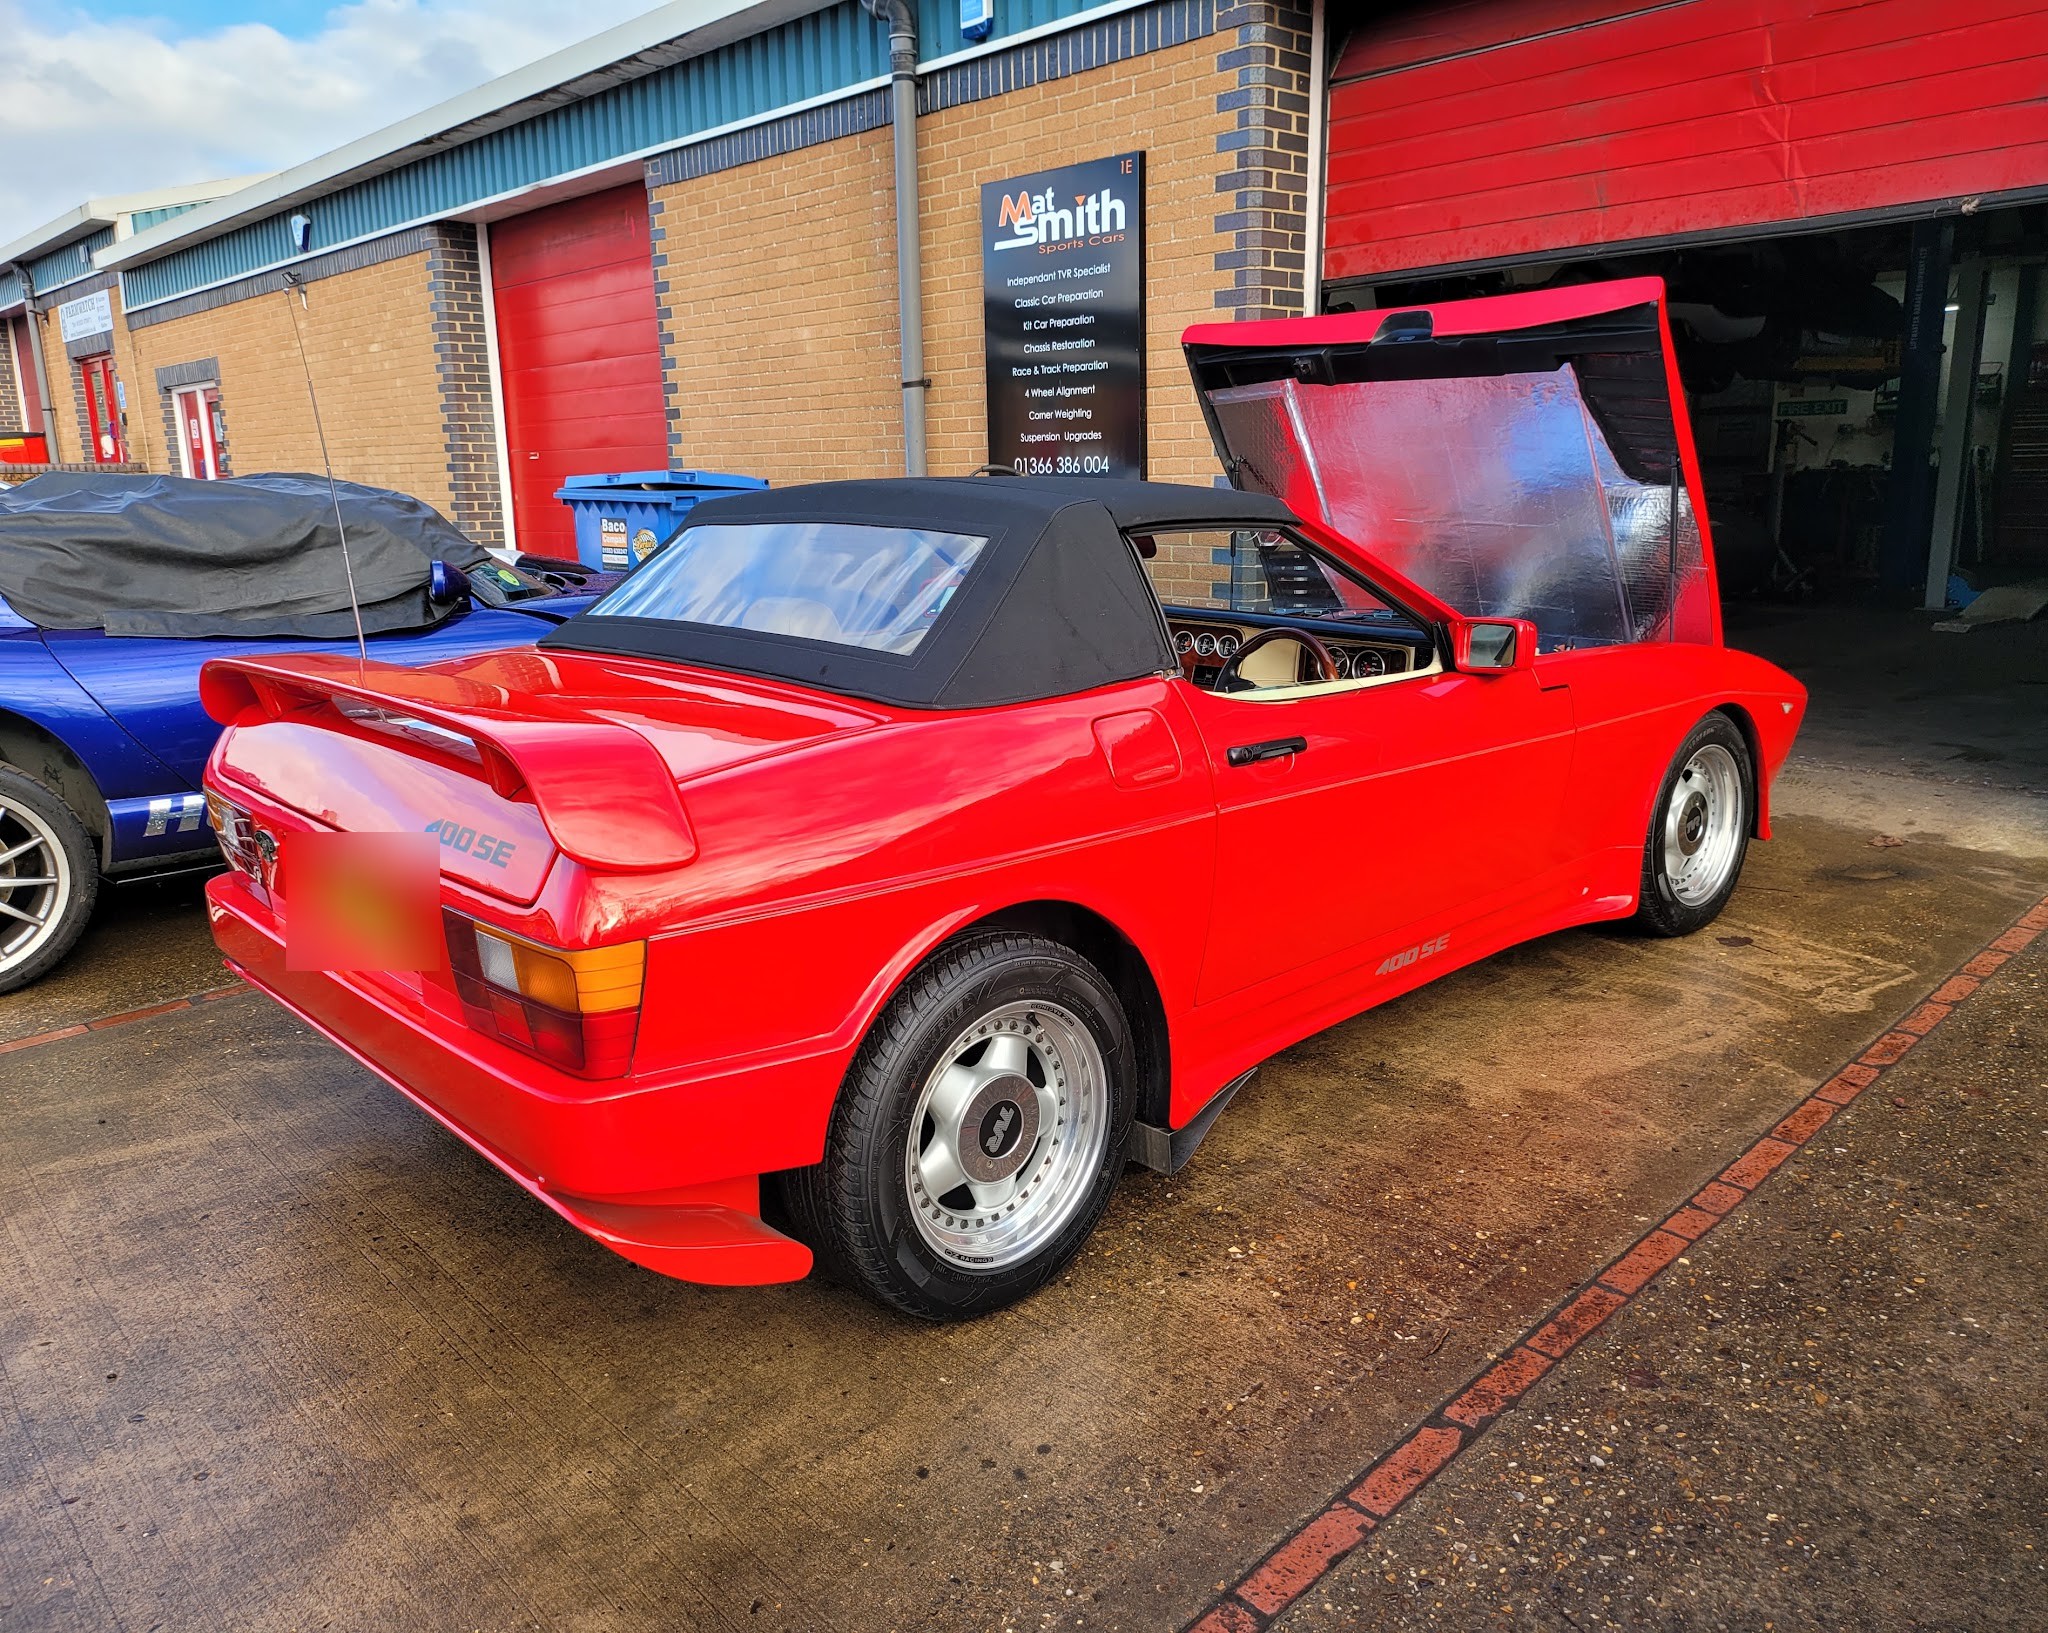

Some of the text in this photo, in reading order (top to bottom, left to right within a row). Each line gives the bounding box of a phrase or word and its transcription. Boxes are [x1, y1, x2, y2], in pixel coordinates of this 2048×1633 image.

[1120, 159, 1133, 175] 1E
[998, 186, 1055, 228] Mat
[1038, 232, 1125, 255] Sports Cars
[1007, 263, 1111, 287] Independant TVR Specialist
[1014, 288, 1104, 309] Classic Car Preparation
[1023, 314, 1095, 331] Kit Car Preparation
[1023, 338, 1095, 354] Chassis Restoration
[1012, 360, 1109, 377] Race & Track Preparation
[1024, 384, 1096, 398] 4 Wheel Alignment
[1028, 408, 1092, 421] Corner Weighting
[1020, 430, 1102, 443] Suspension Upgrades
[1014, 455, 1110, 475] 01366 386 004
[601, 518, 626, 533] Baco
[1374, 932, 1452, 976] 400 SE
[985, 1105, 1015, 1154] TVR
[960, 1255, 988, 1263] RACING
